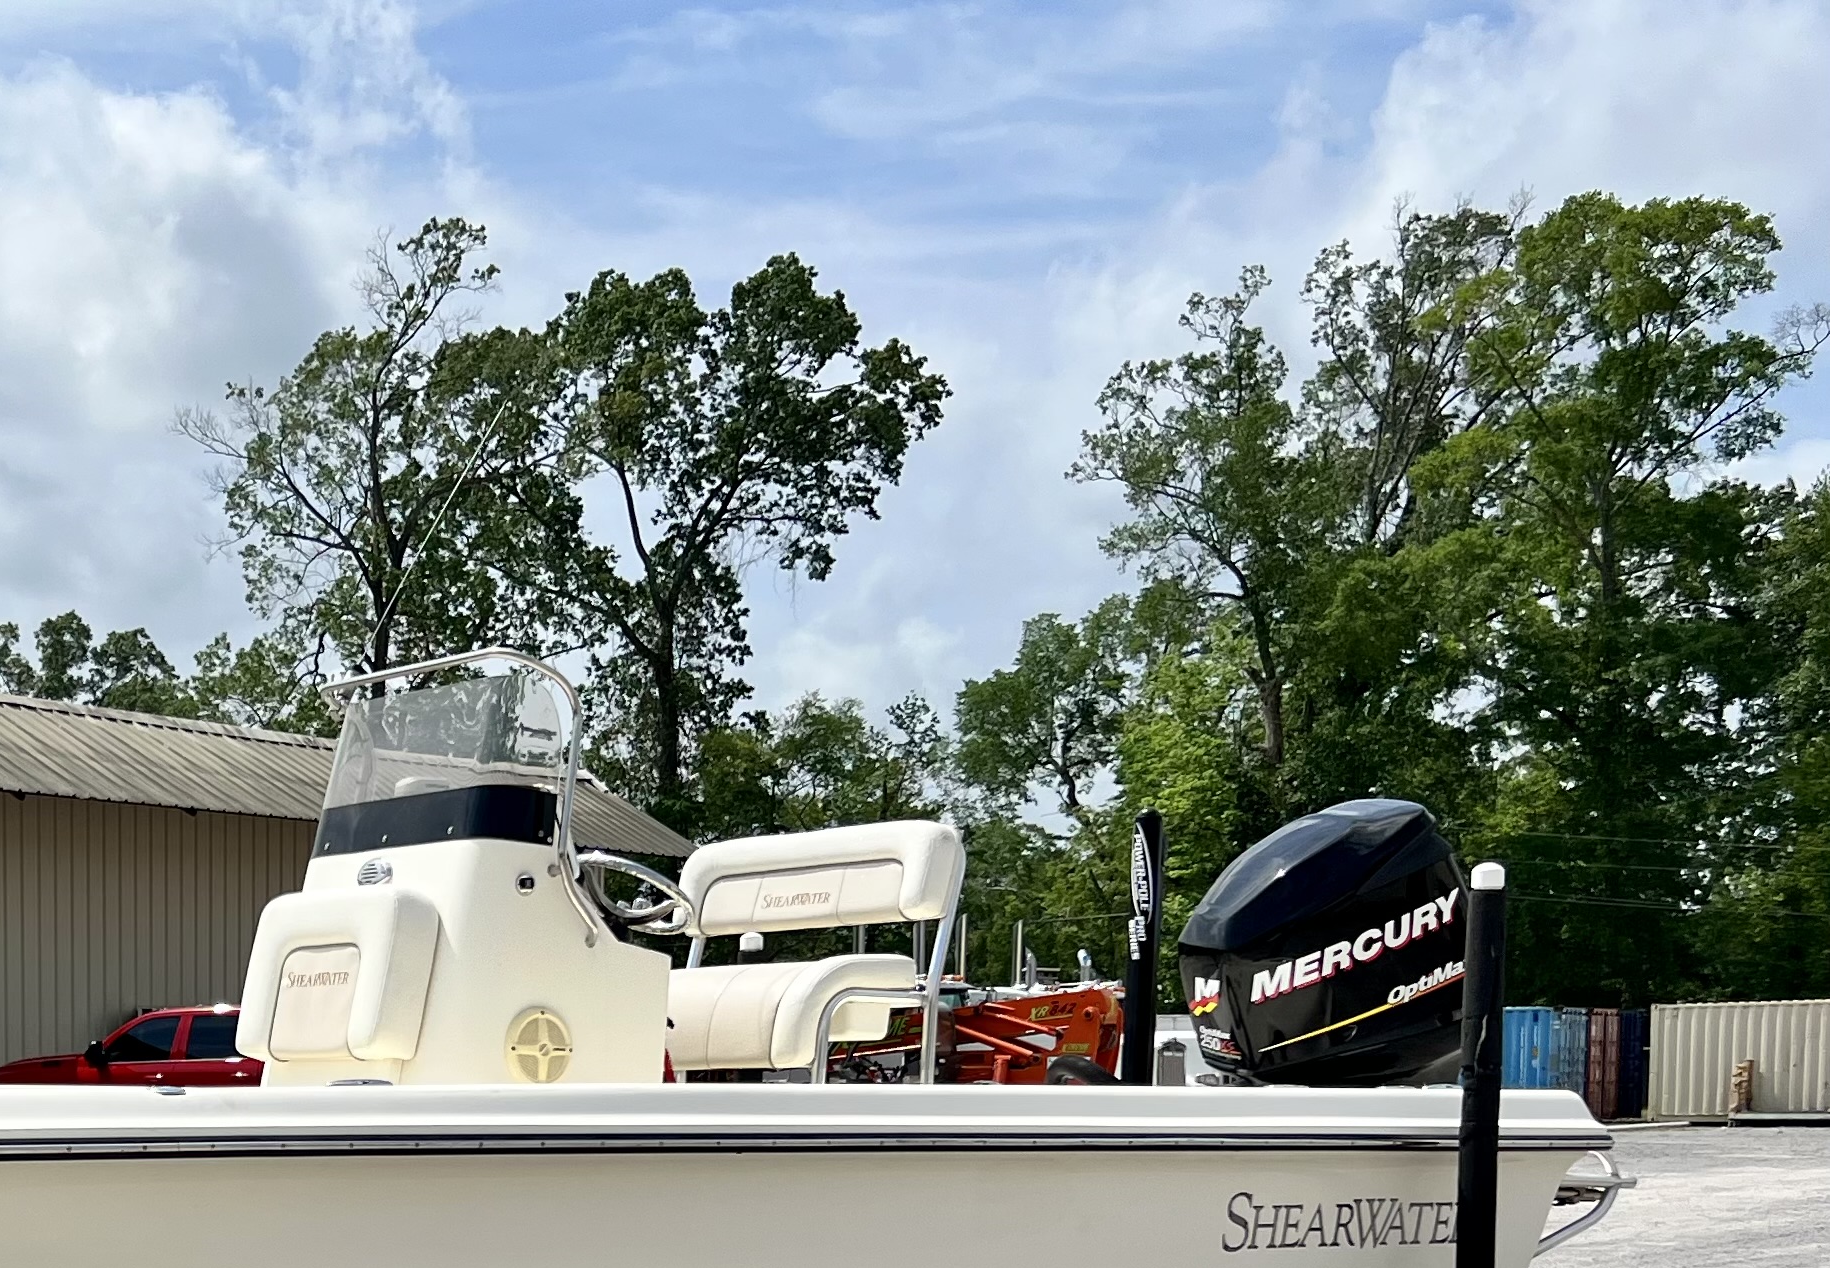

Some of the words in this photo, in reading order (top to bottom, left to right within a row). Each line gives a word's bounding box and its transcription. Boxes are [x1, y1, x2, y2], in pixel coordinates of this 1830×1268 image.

[1250, 887, 1459, 1004] MERCURY
[1387, 959, 1467, 1006] OptiMa
[1221, 1191, 1458, 1253] SHEARWATE
